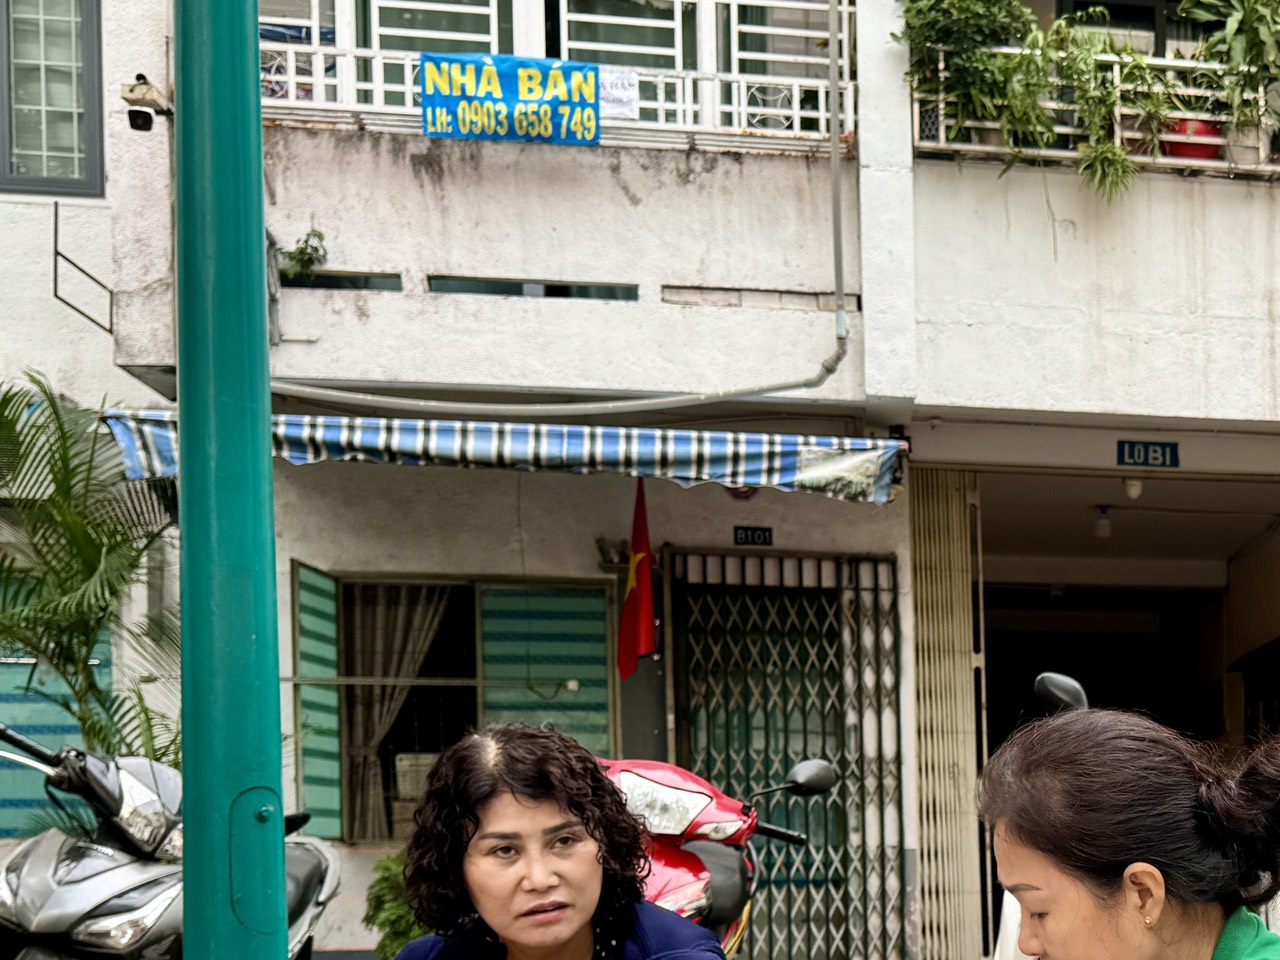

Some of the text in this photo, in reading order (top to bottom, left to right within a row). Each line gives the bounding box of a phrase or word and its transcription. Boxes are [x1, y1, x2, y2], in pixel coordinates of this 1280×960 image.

[424, 57, 595, 104] NHÀ BÁN
[426, 100, 597, 141] LH: 0903 658 749
[736, 529, 771, 545] B101
